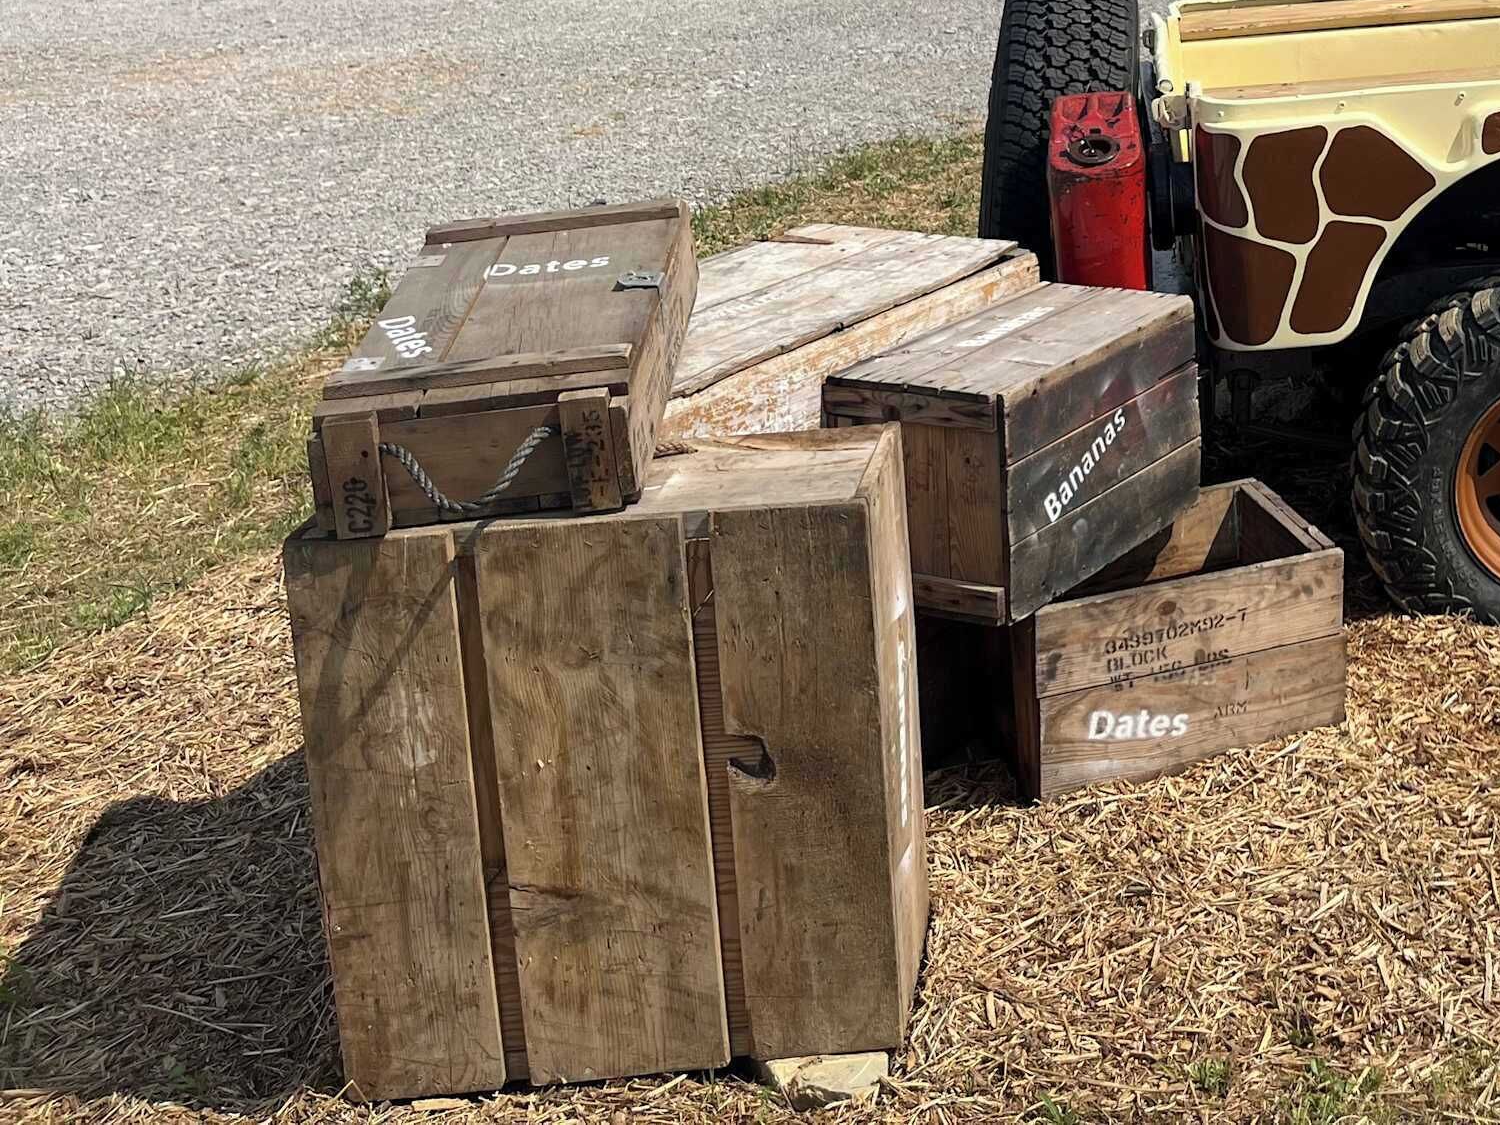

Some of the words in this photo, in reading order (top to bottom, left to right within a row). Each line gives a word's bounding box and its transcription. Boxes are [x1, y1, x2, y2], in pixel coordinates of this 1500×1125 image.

[483, 255, 611, 281] Dates
[378, 315, 433, 359] Dates
[1043, 408, 1126, 523] Bananas
[1107, 646, 1168, 673] BLOCK
[1088, 709, 1189, 740] Dates
